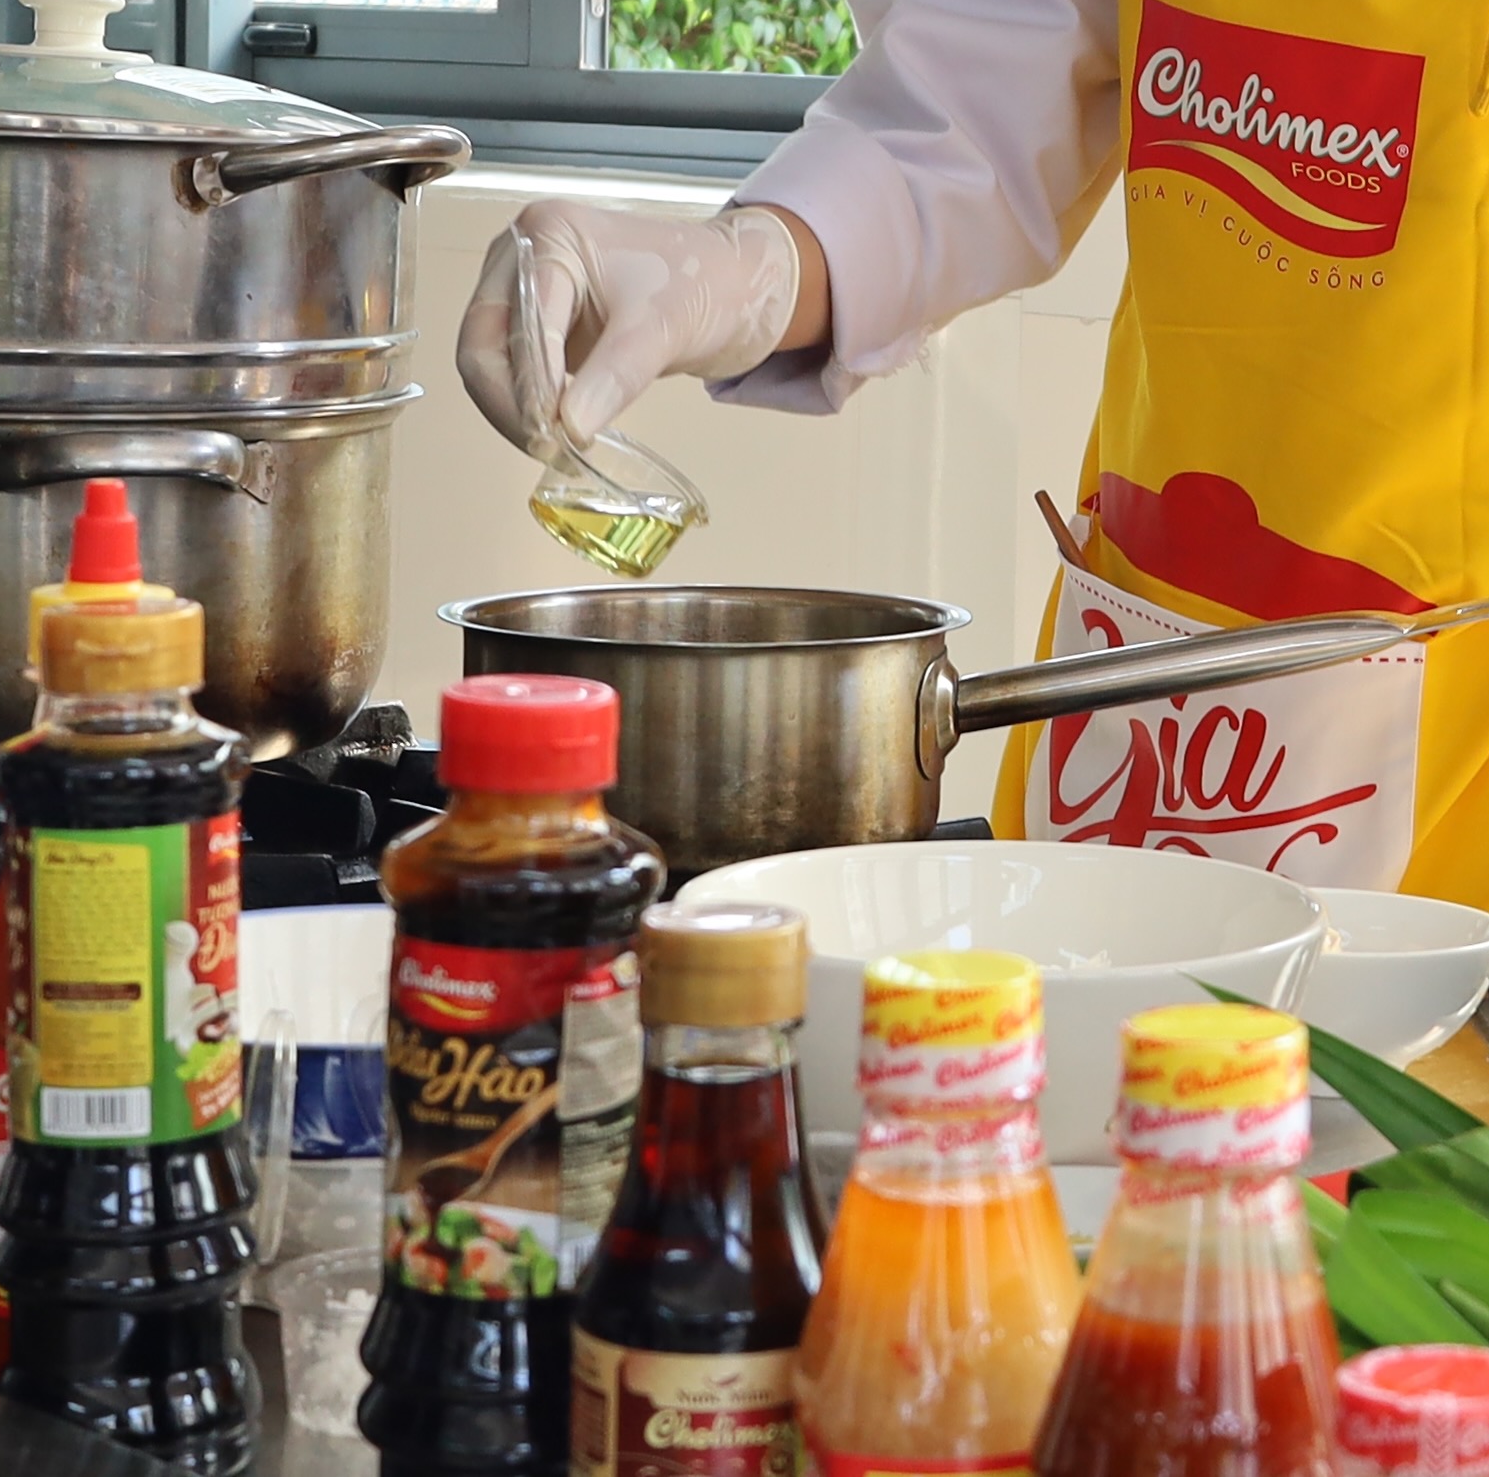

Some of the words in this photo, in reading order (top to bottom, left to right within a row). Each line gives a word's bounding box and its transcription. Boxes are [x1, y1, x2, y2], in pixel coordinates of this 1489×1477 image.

[1290, 161, 1382, 195] FOODS
[1130, 184, 1166, 203] GIA
[1183, 189, 1207, 219] VỊ
[1222, 216, 1290, 273] CUỘC
[1308, 264, 1386, 290] SỐNG
